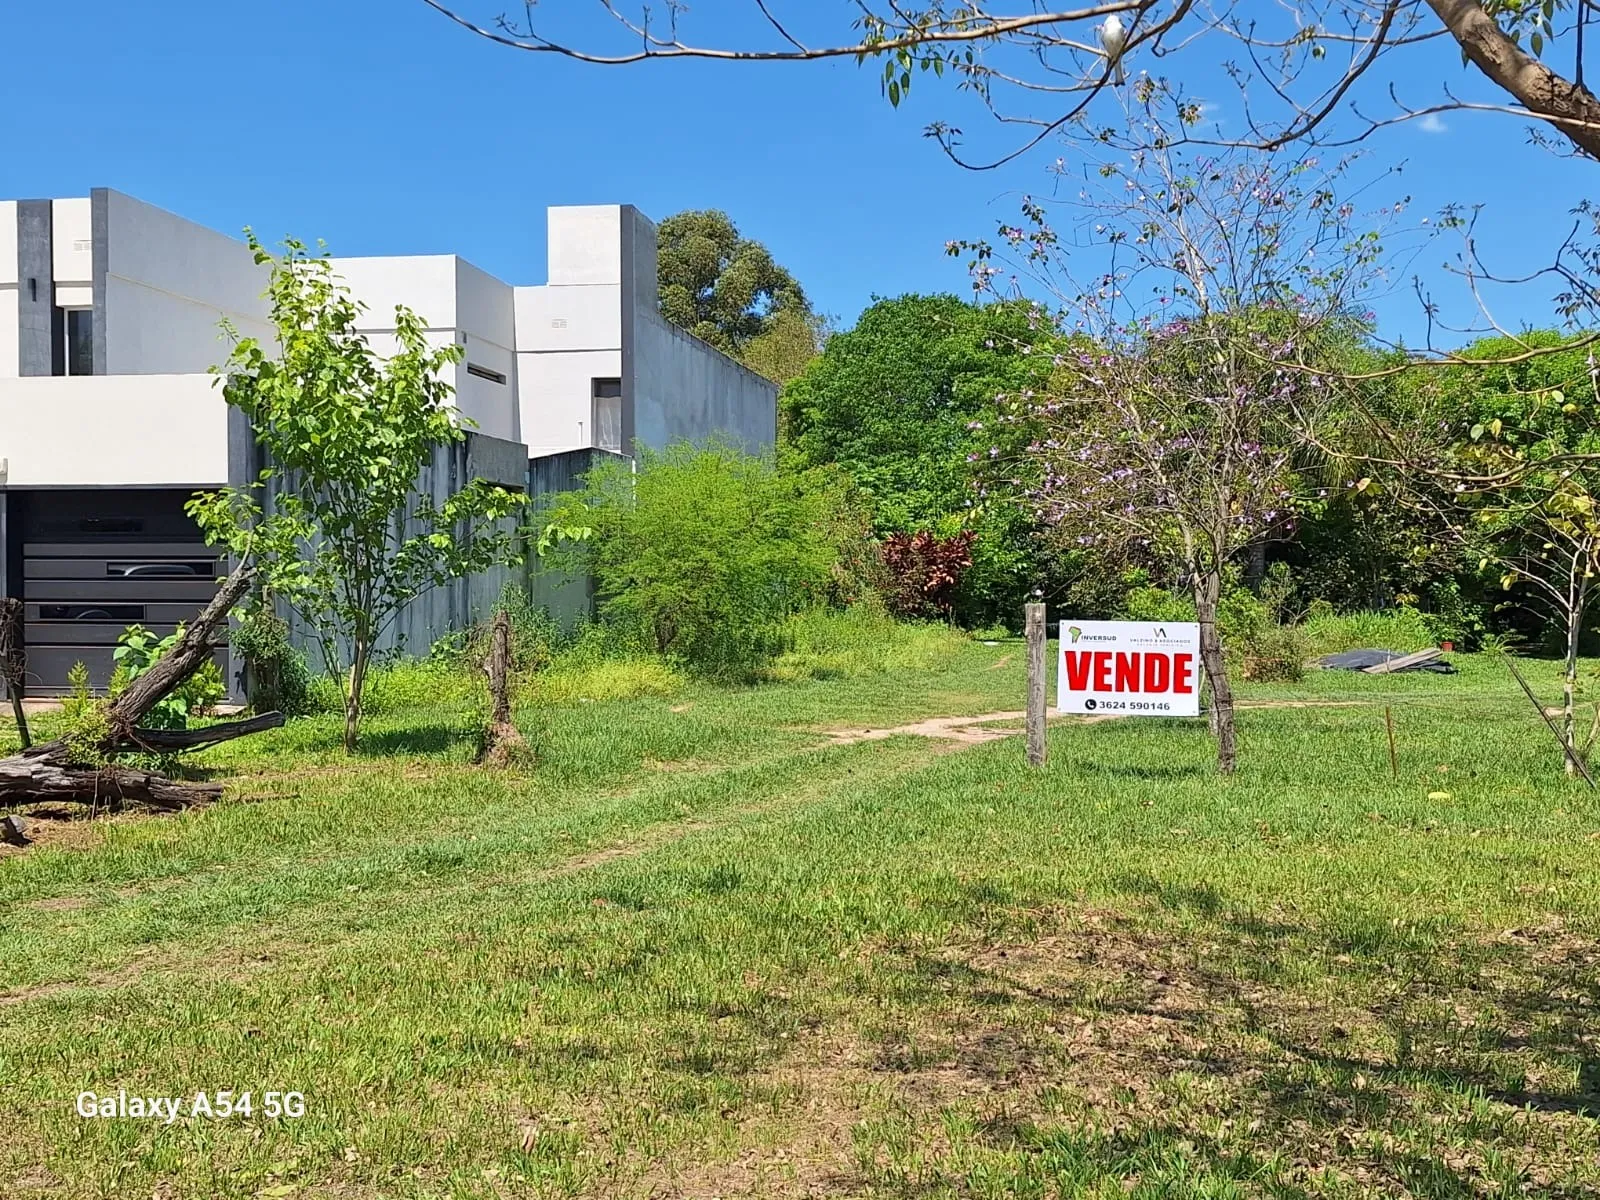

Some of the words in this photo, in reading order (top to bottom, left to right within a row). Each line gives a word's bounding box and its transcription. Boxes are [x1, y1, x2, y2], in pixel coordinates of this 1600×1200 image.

[1064, 651, 1193, 694] VENDE
[1099, 701, 1126, 709] 3624
[1129, 702, 1171, 711] 590146
